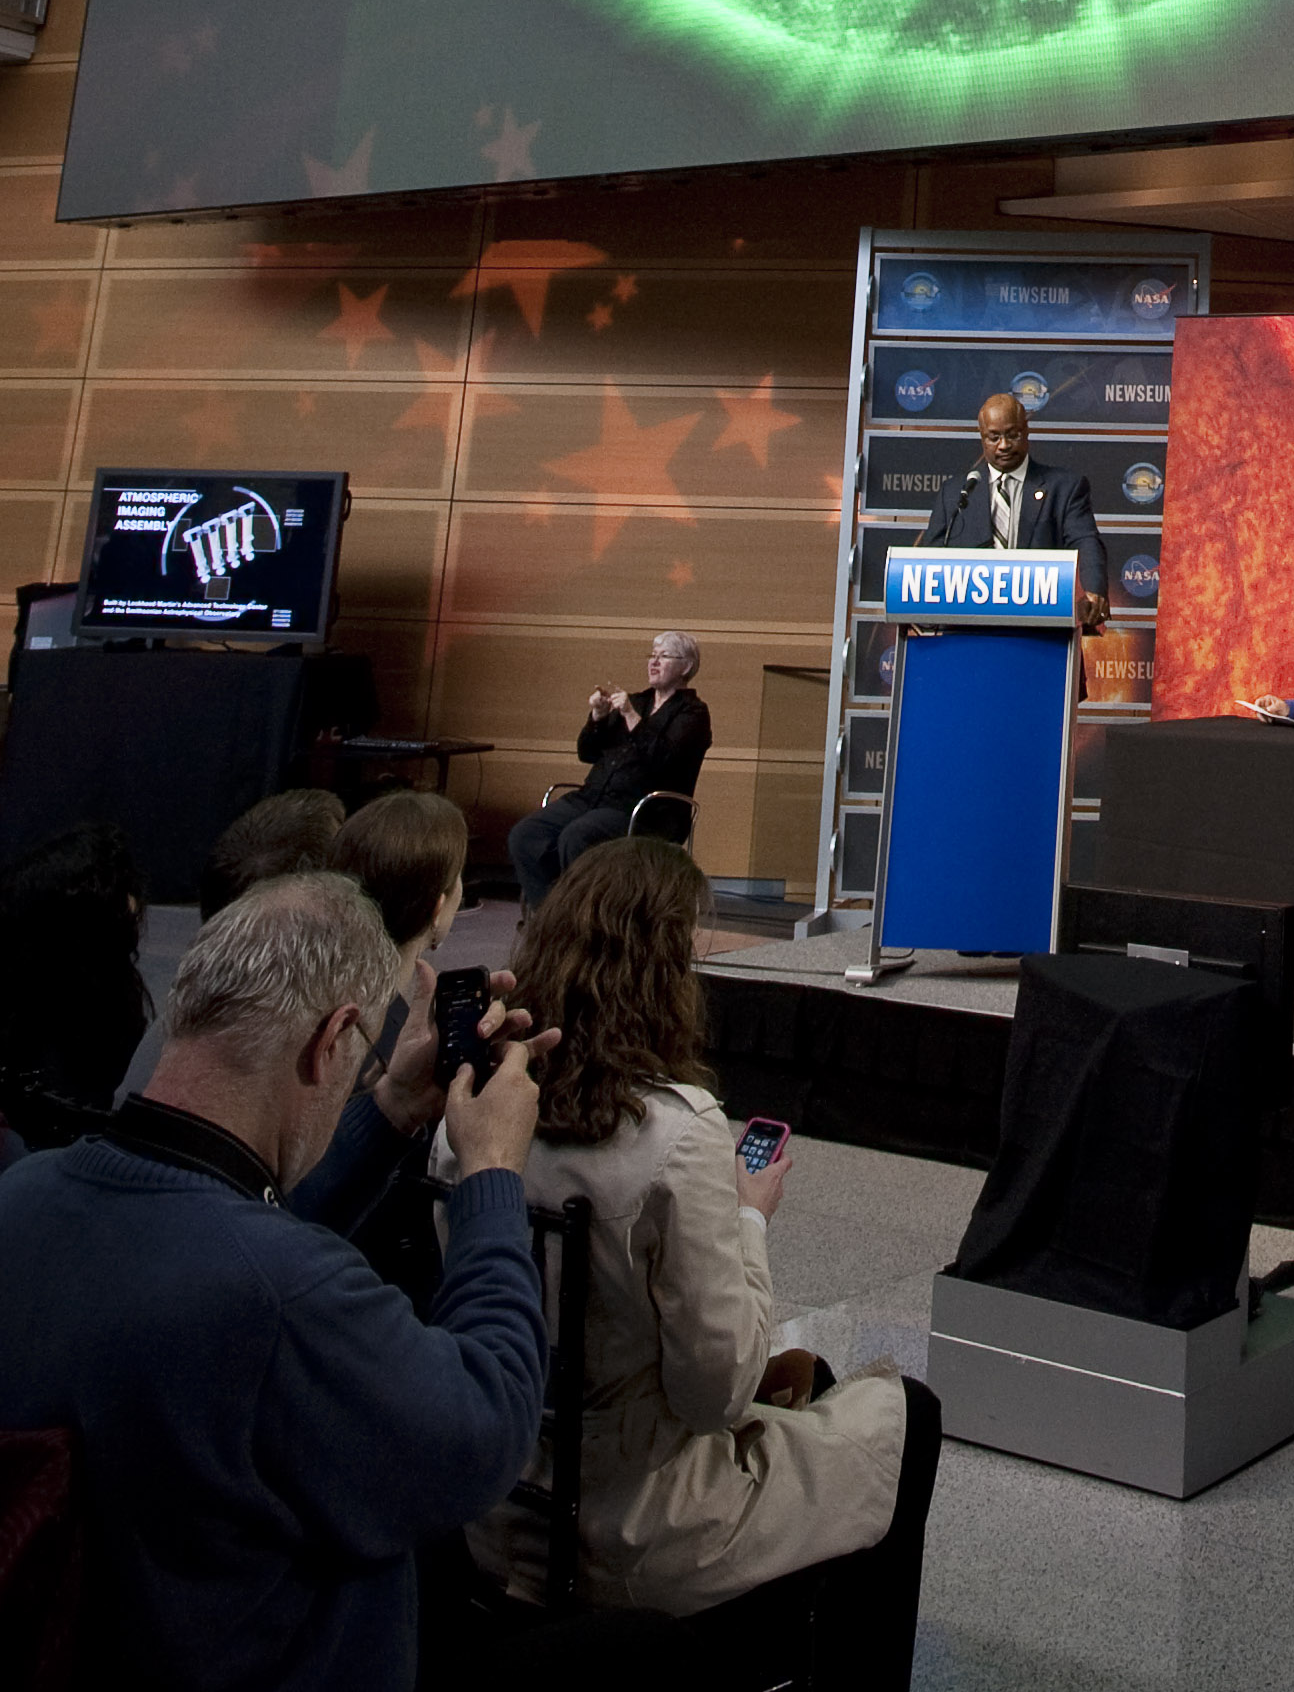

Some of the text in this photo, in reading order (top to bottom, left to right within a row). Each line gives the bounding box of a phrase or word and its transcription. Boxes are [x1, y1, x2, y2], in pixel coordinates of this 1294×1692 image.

[999, 286, 1070, 305] NEWSEUM
[1134, 293, 1170, 305] NASA
[897, 385, 933, 397] NASA
[882, 473, 953, 492] NEWSEU
[118, 491, 199, 504] ATMOSPHERIC
[116, 505, 166, 517] IMAGING
[114, 519, 173, 531] ASSEMBLY
[1124, 570, 1160, 581] NASA
[901, 564, 1060, 606] NEWSEUM
[1095, 660, 1154, 680] NEWSEU
